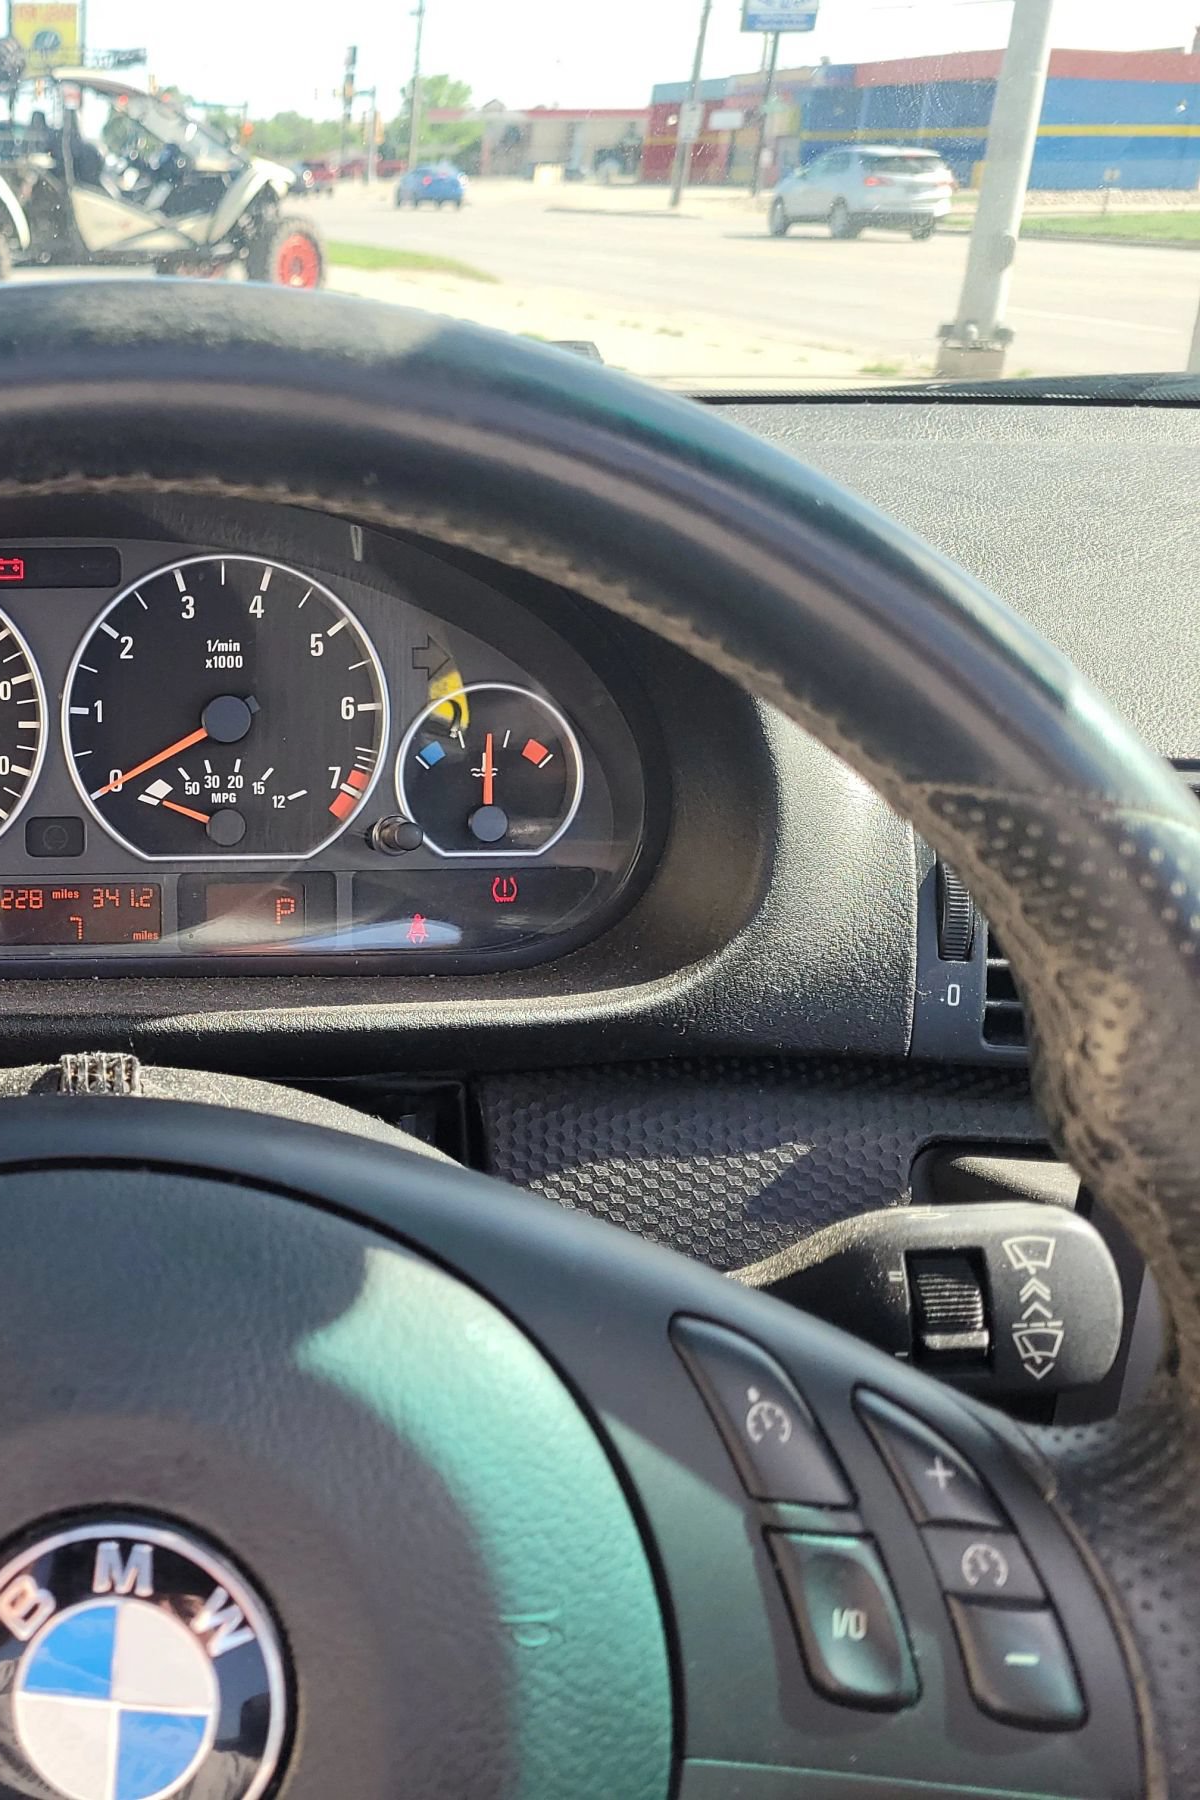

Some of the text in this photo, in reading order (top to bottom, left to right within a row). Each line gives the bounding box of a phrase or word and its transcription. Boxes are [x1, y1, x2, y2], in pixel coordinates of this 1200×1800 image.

[181, 595, 195, 620] 3
[249, 595, 265, 619] 4
[119, 635, 134, 659] 2
[206, 639, 241, 653] 1/min
[310, 633, 324, 656] 5
[205, 656, 243, 669] x1000
[93, 699, 103, 723] 1
[340, 696, 355, 720] 6
[204, 775, 220, 789] 30
[227, 775, 243, 789] 20
[328, 766, 341, 789] 7
[184, 782, 200, 795] 50
[251, 782, 265, 795] 15
[211, 793, 237, 804] MPG
[271, 796, 286, 808] 12
[52, 889, 80, 900] miles
[276, 896, 295, 924] P
[69, 916, 84, 940] 7
[132, 931, 160, 941] miles
